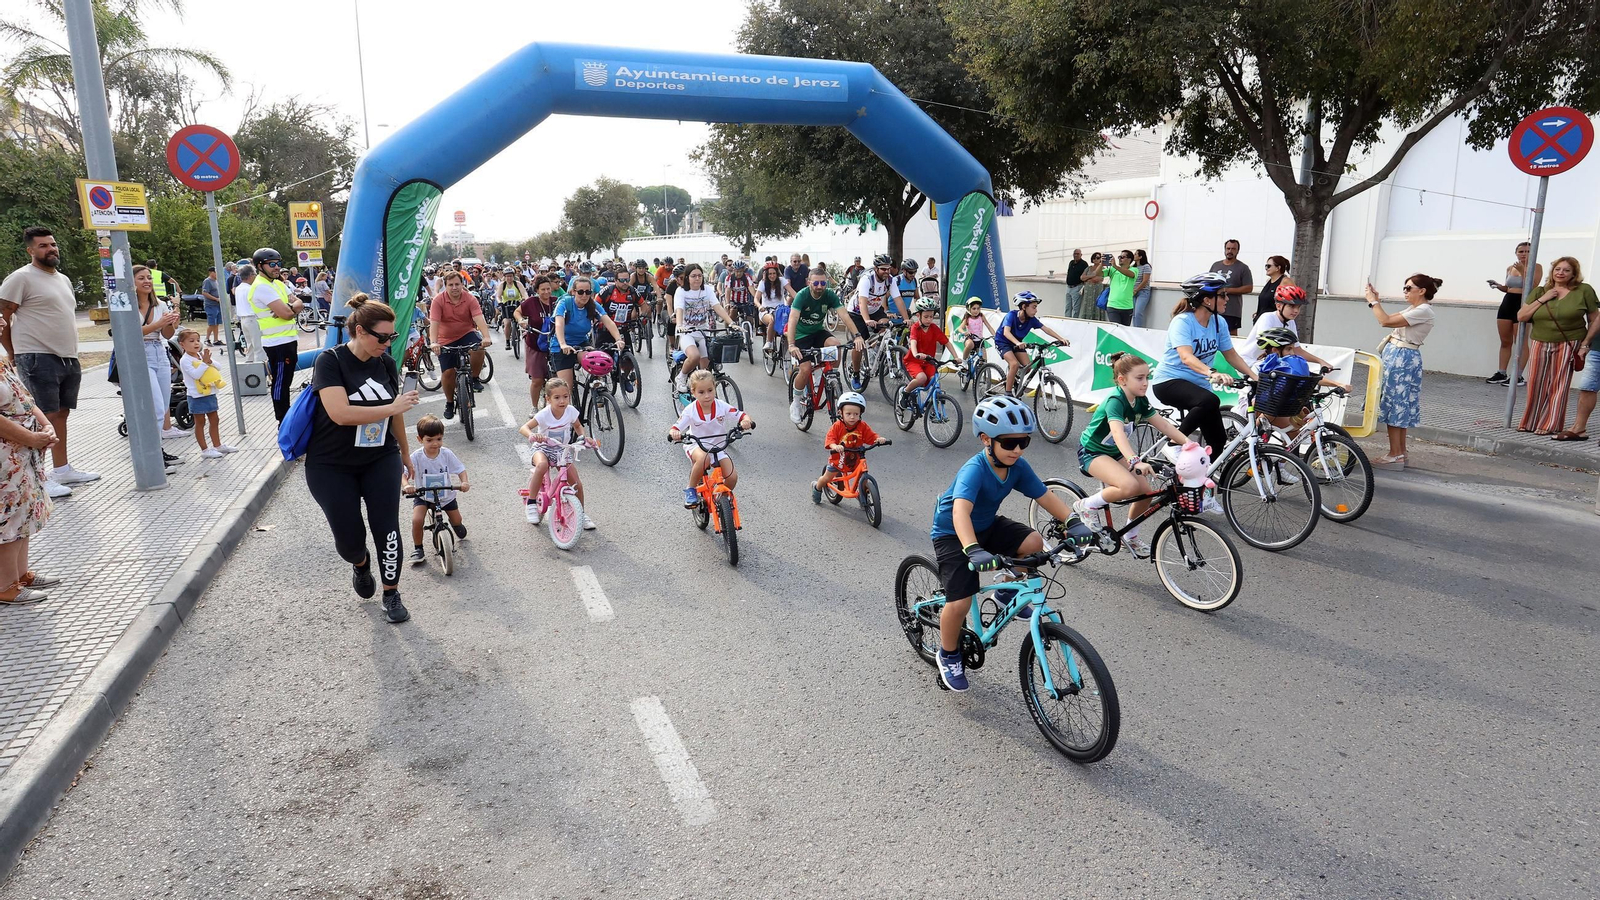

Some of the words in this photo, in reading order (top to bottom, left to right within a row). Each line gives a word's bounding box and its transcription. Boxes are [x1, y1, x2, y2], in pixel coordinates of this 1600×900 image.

[615, 66, 761, 84] Ayuntamiento
[766, 75, 788, 85] de
[793, 76, 840, 88] Jerez
[615, 78, 685, 91] Deportes
[1192, 337, 1219, 356] Nike
[382, 530, 398, 581] adidas
[994, 597, 1018, 629] BH
